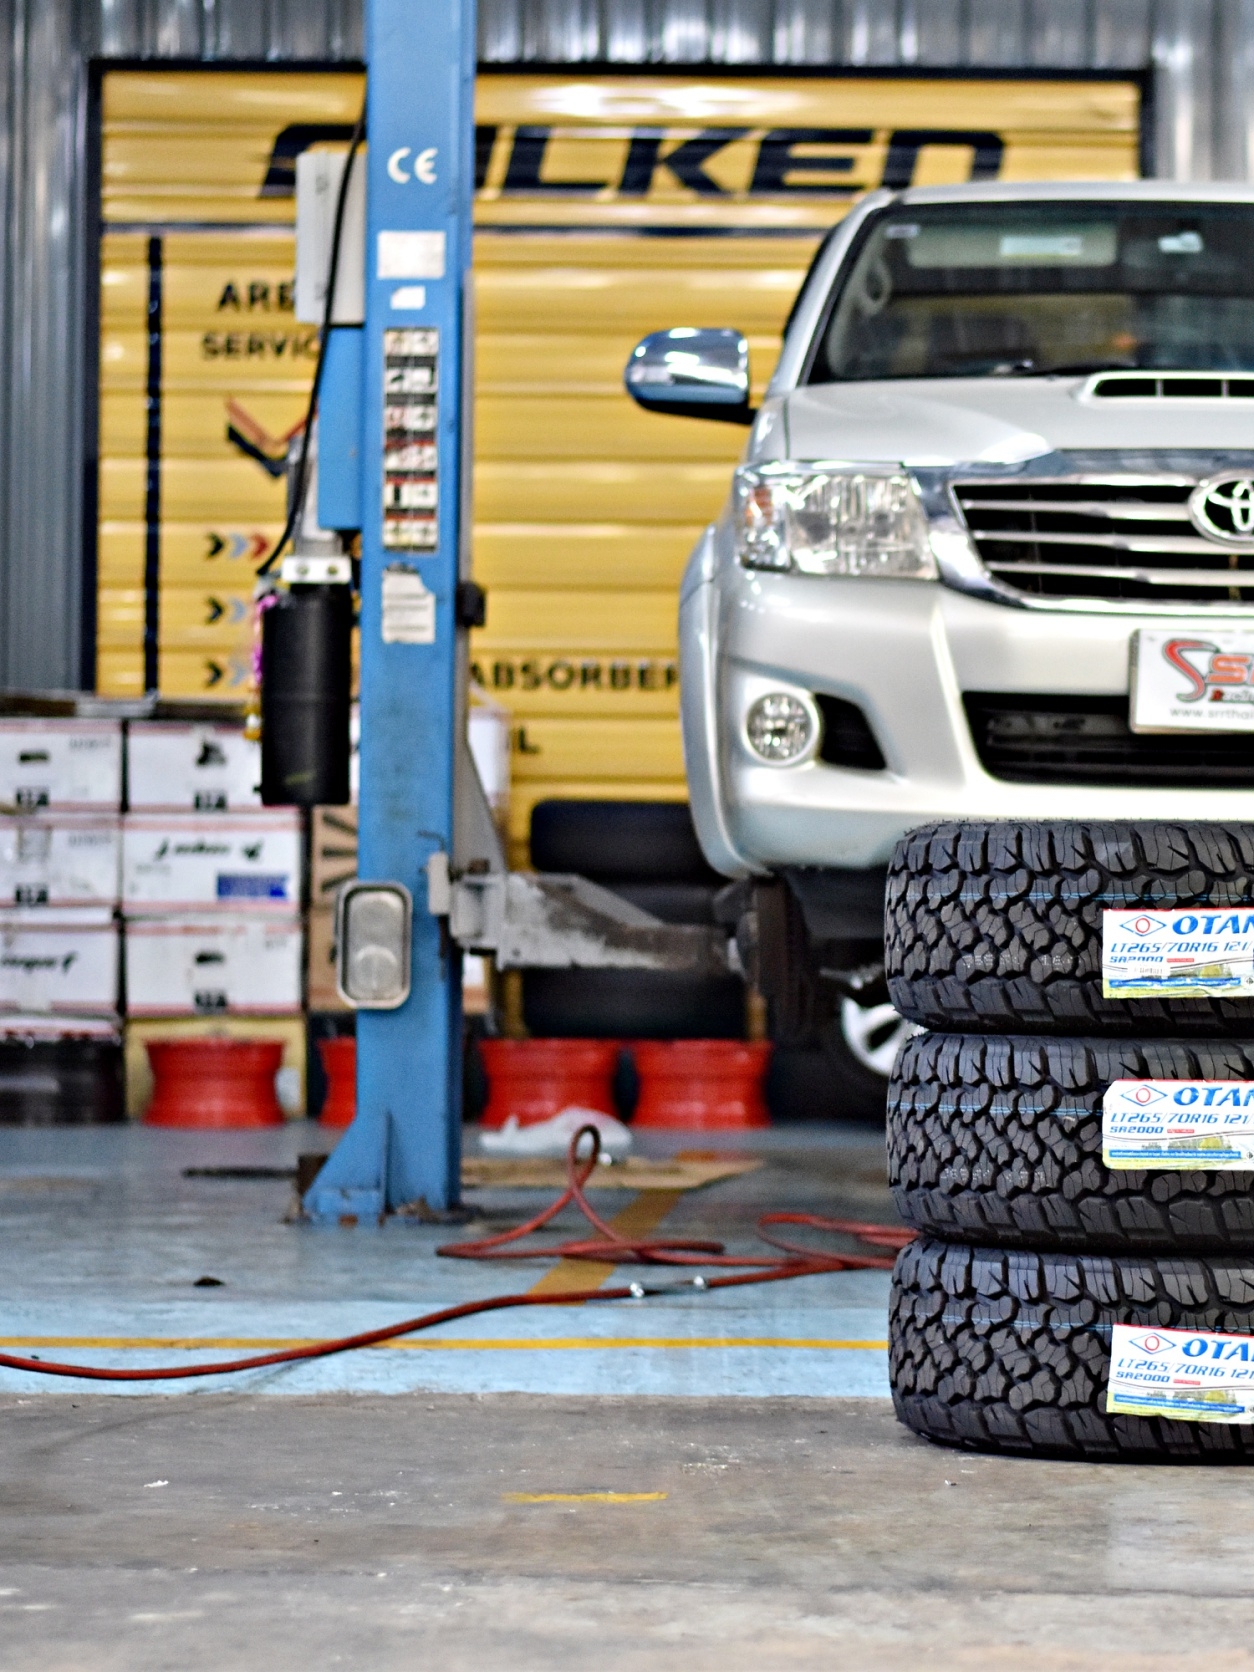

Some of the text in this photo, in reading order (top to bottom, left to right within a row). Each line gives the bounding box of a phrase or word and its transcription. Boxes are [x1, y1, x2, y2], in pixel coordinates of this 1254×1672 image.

[386, 146, 439, 185] CE
[1110, 1113, 1219, 1124] LT265/70R16
[1118, 1358, 1225, 1377] LT265/70R16
